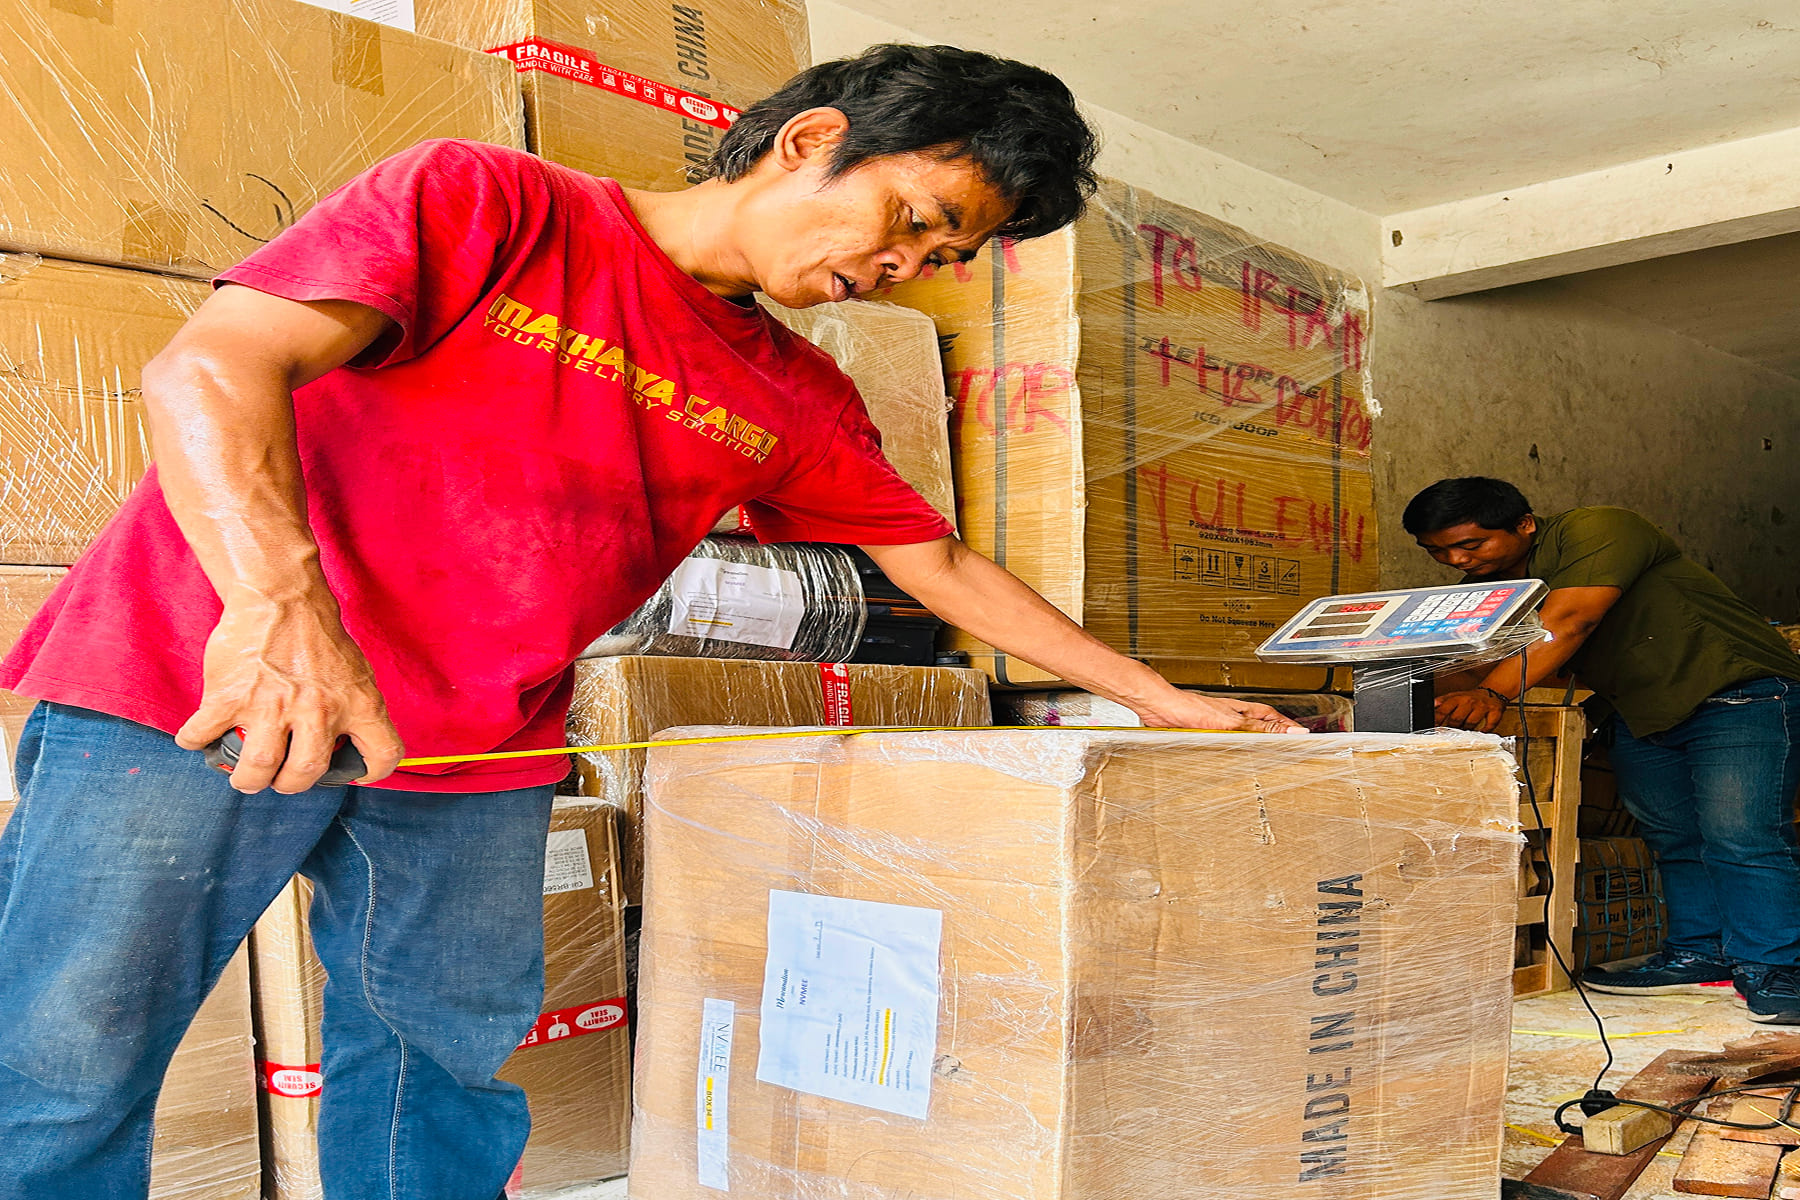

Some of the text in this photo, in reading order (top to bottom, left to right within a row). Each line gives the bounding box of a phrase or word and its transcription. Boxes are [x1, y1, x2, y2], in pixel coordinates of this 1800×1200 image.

[672, 3, 711, 81] CHINA
[516, 44, 590, 72] FRAGILE
[516, 60, 595, 83] HANDLE WITH CARE
[685, 97, 714, 112] SECURITY
[692, 106, 708, 117] SEAL
[483, 315, 559, 354] YOUR
[665, 409, 768, 465] SOLUTION
[685, 394, 778, 456] CARGO
[1212, 615, 1226, 624] Not
[1258, 620, 1276, 629] Here
[825, 681, 834, 703] HANDLE
[583, 1014, 617, 1026] SECURITY
[590, 1009, 608, 1018] SEAL
[1299, 873, 1363, 1183] MADE IN CHINA
[713, 1022, 730, 1073] NVMEE
